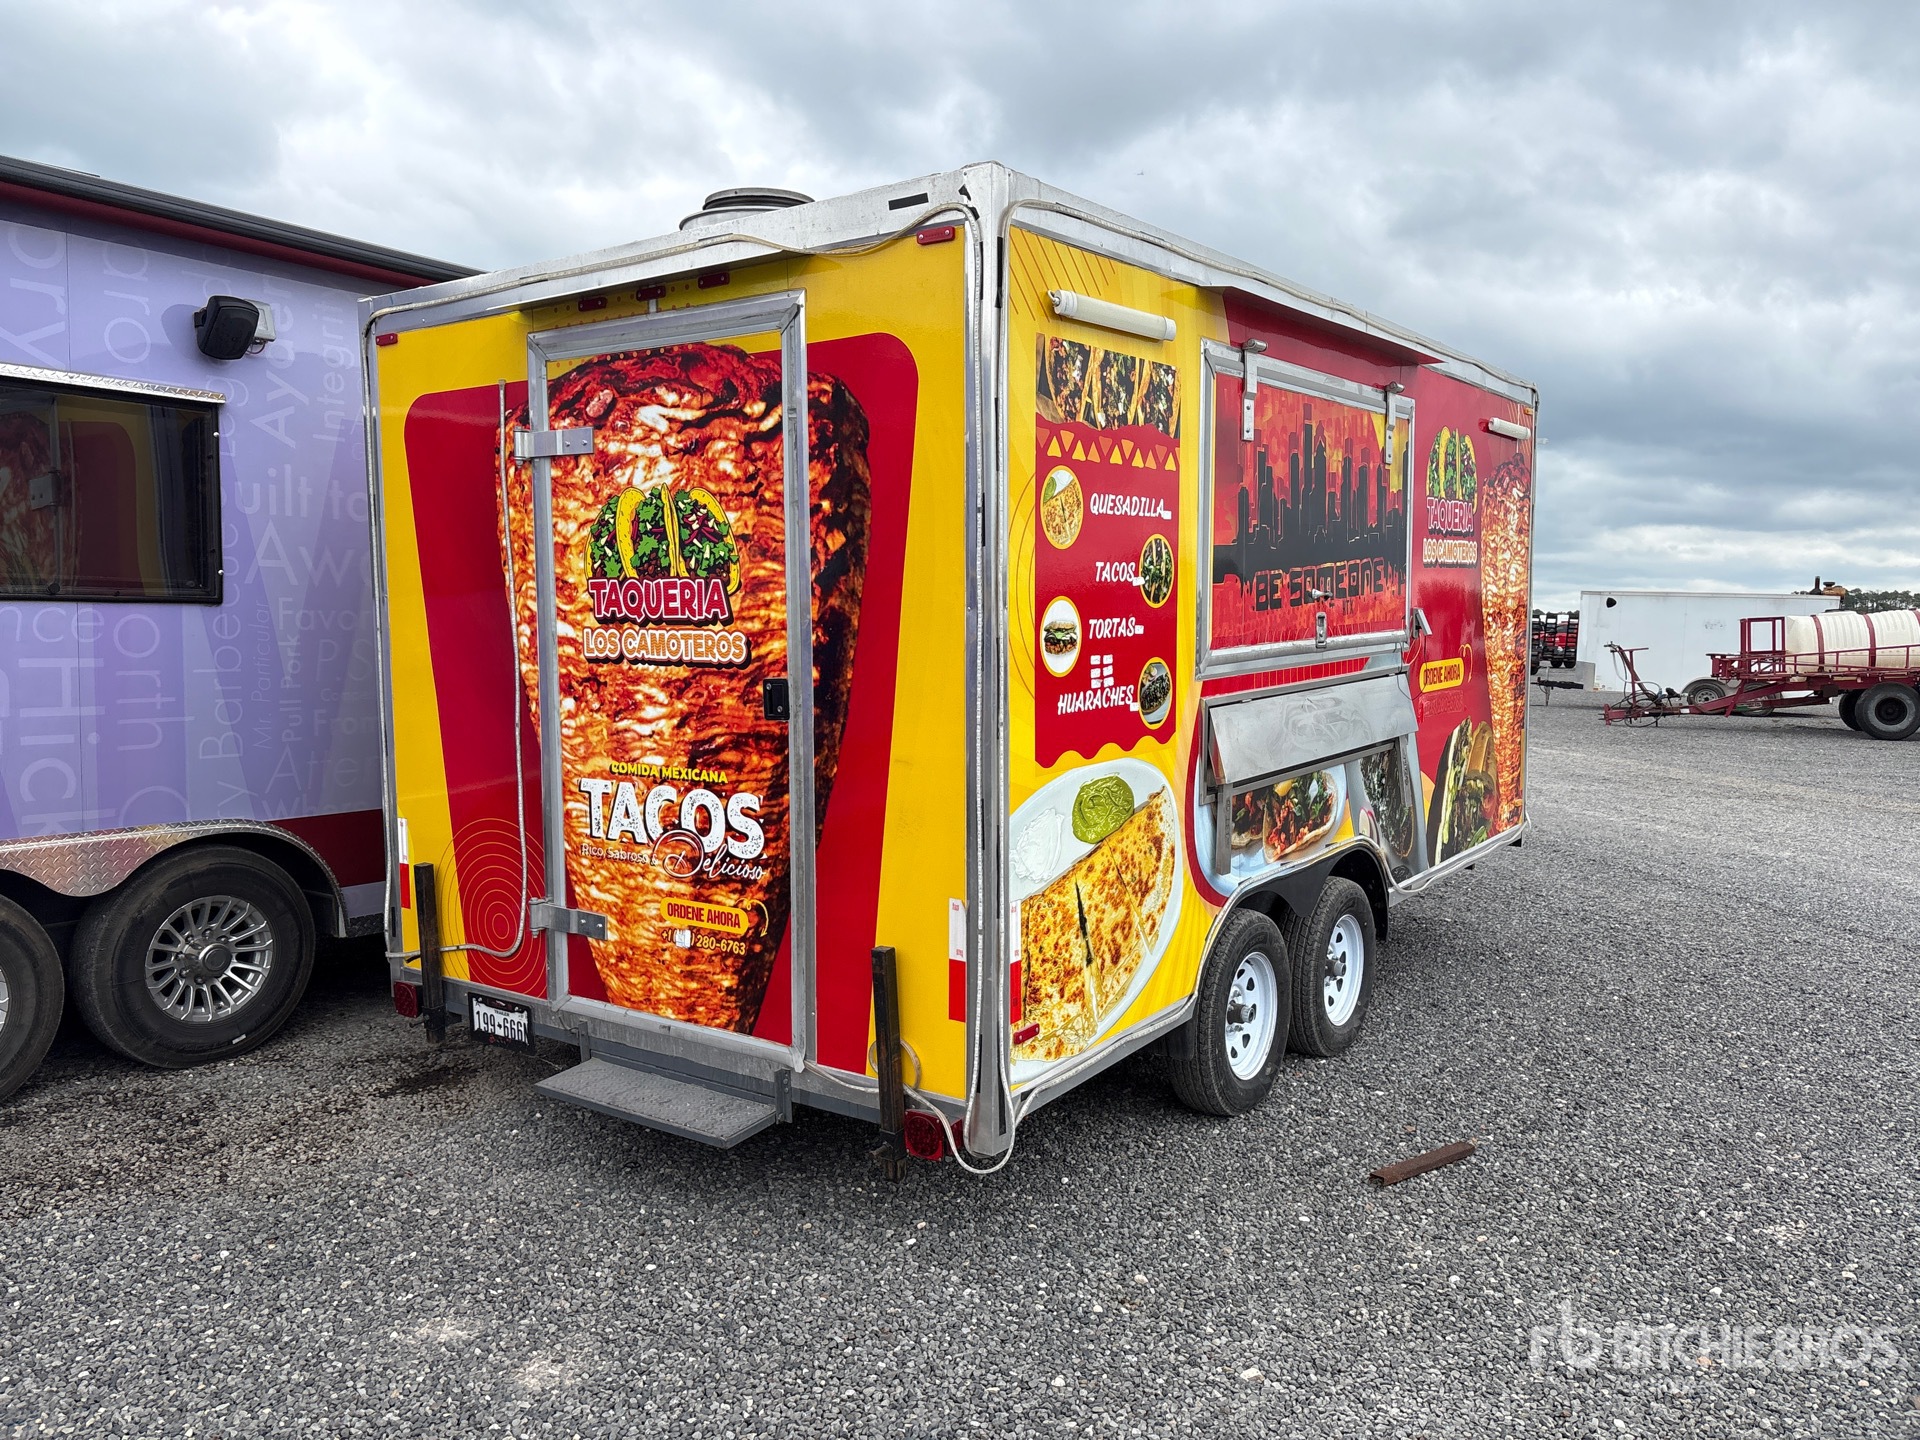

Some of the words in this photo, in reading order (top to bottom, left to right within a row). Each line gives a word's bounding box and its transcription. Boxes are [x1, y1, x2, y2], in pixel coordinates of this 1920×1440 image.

[222, 464, 312, 517] uilt
[1090, 493, 1165, 516] QUESADILLA
[1427, 497, 1473, 533] TAQUERIA
[1423, 538, 1437, 562] LOS
[1437, 539, 1477, 565] CAMOTEROS
[1095, 562, 1135, 582] TACOS
[589, 579, 728, 622] TAQUERIA
[1255, 569, 1283, 611] BE
[1089, 617, 1136, 639] TORTAS
[584, 629, 619, 656] LOS
[623, 629, 746, 662] CAMOTEROS
[1057, 685, 1135, 715] HUARACHES
[279, 699, 303, 742] Pull
[611, 762, 659, 777] COMIDA
[662, 766, 728, 783] MEXICANA
[580, 778, 765, 859] TACOS
[667, 903, 706, 923] ORDENE
[706, 909, 741, 929] AHORA
[696, 935, 746, 956] 280-6763
